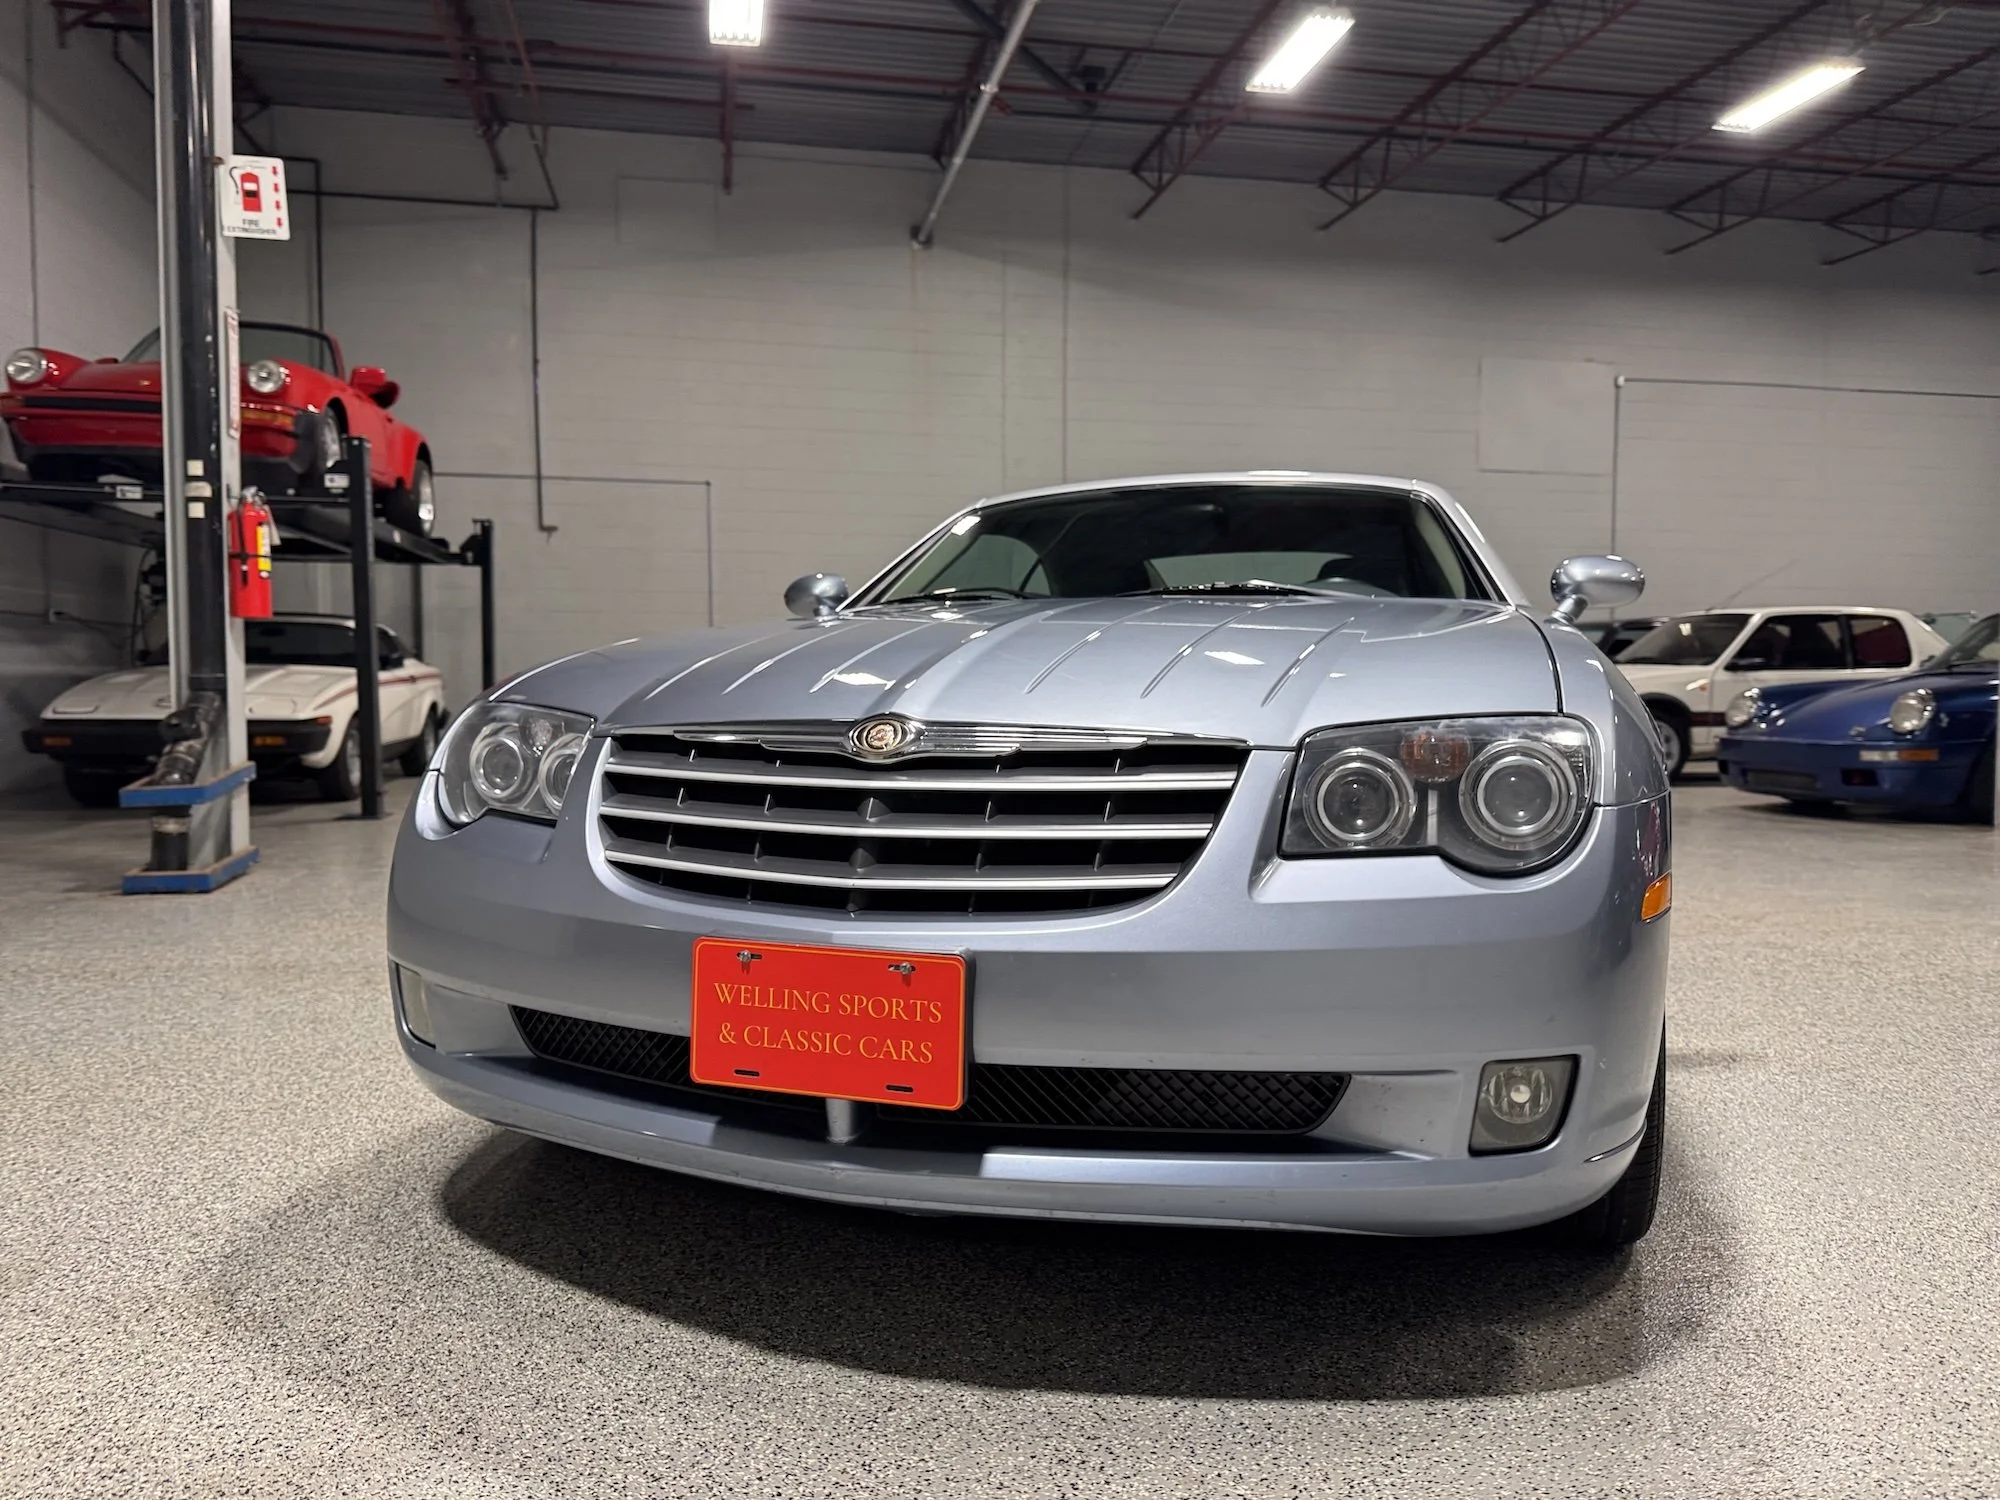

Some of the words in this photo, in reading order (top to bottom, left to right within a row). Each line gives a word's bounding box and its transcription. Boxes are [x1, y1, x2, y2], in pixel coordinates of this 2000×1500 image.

[242, 218, 260, 227] FIRE
[713, 982, 830, 1014] WELLING
[839, 993, 942, 1024] SPORTS
[719, 1022, 737, 1045] &
[743, 1025, 852, 1057] CLASSIC
[859, 1036, 933, 1064] CARS
